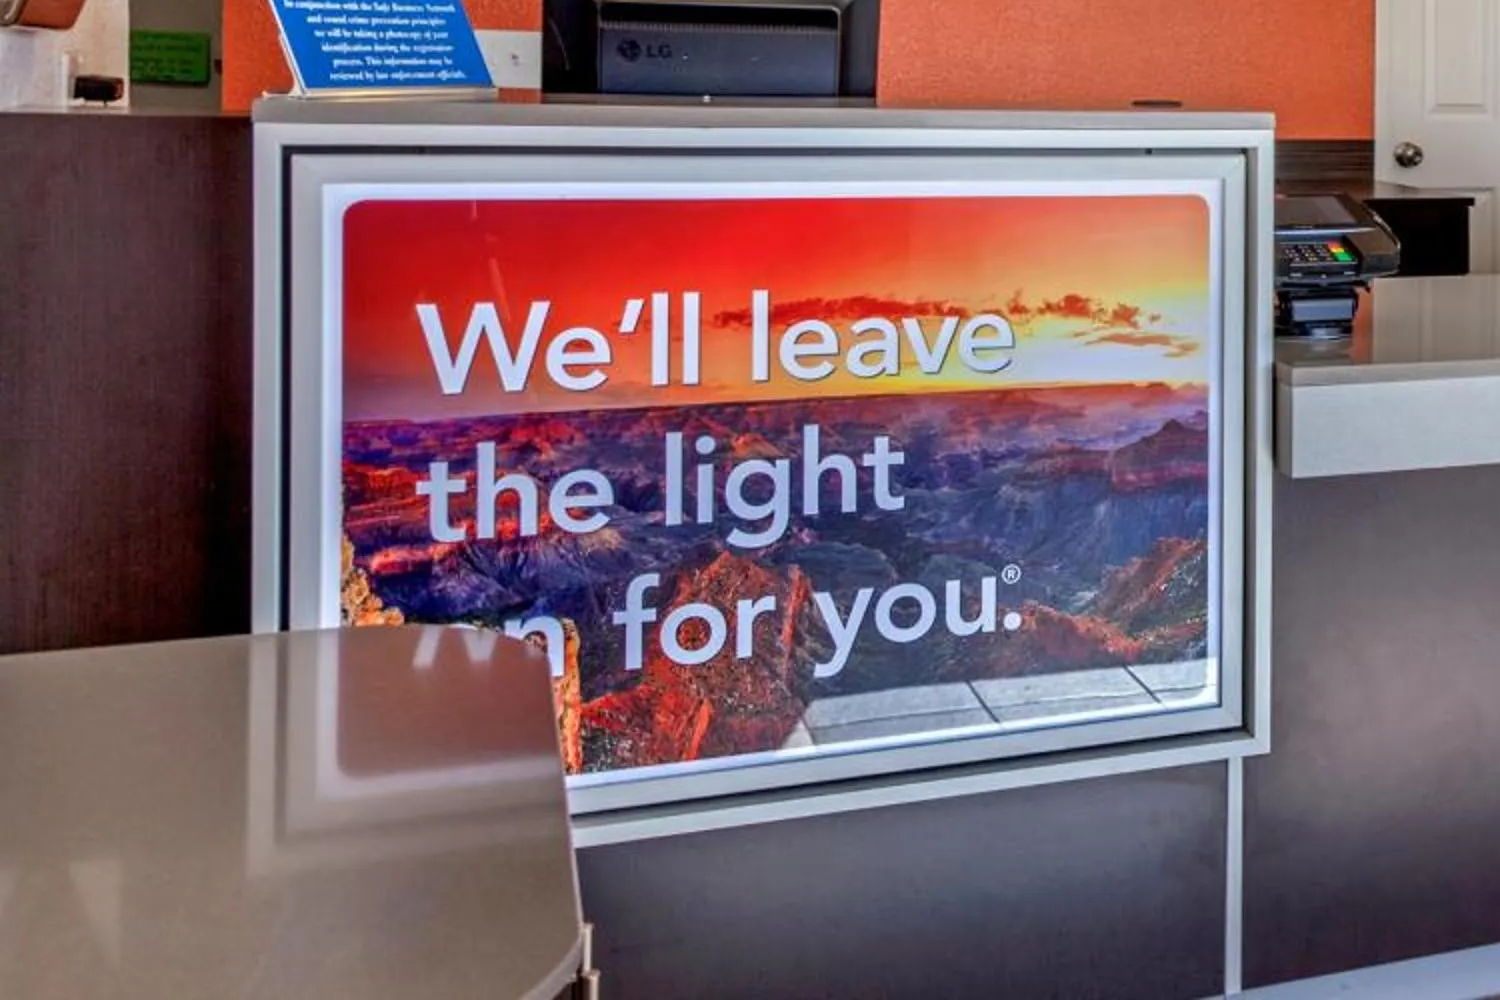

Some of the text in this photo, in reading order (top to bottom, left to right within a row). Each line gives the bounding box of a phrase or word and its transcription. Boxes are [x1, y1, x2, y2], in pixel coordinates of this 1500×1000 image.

[342, 1, 359, 10] with
[360, 1, 372, 11] the
[307, 14, 322, 23] and
[327, 27, 342, 37] will
[646, 44, 672, 58] LG
[416, 289, 1016, 395] We'll leave
[415, 425, 906, 549] the light
[612, 573, 777, 672] for
